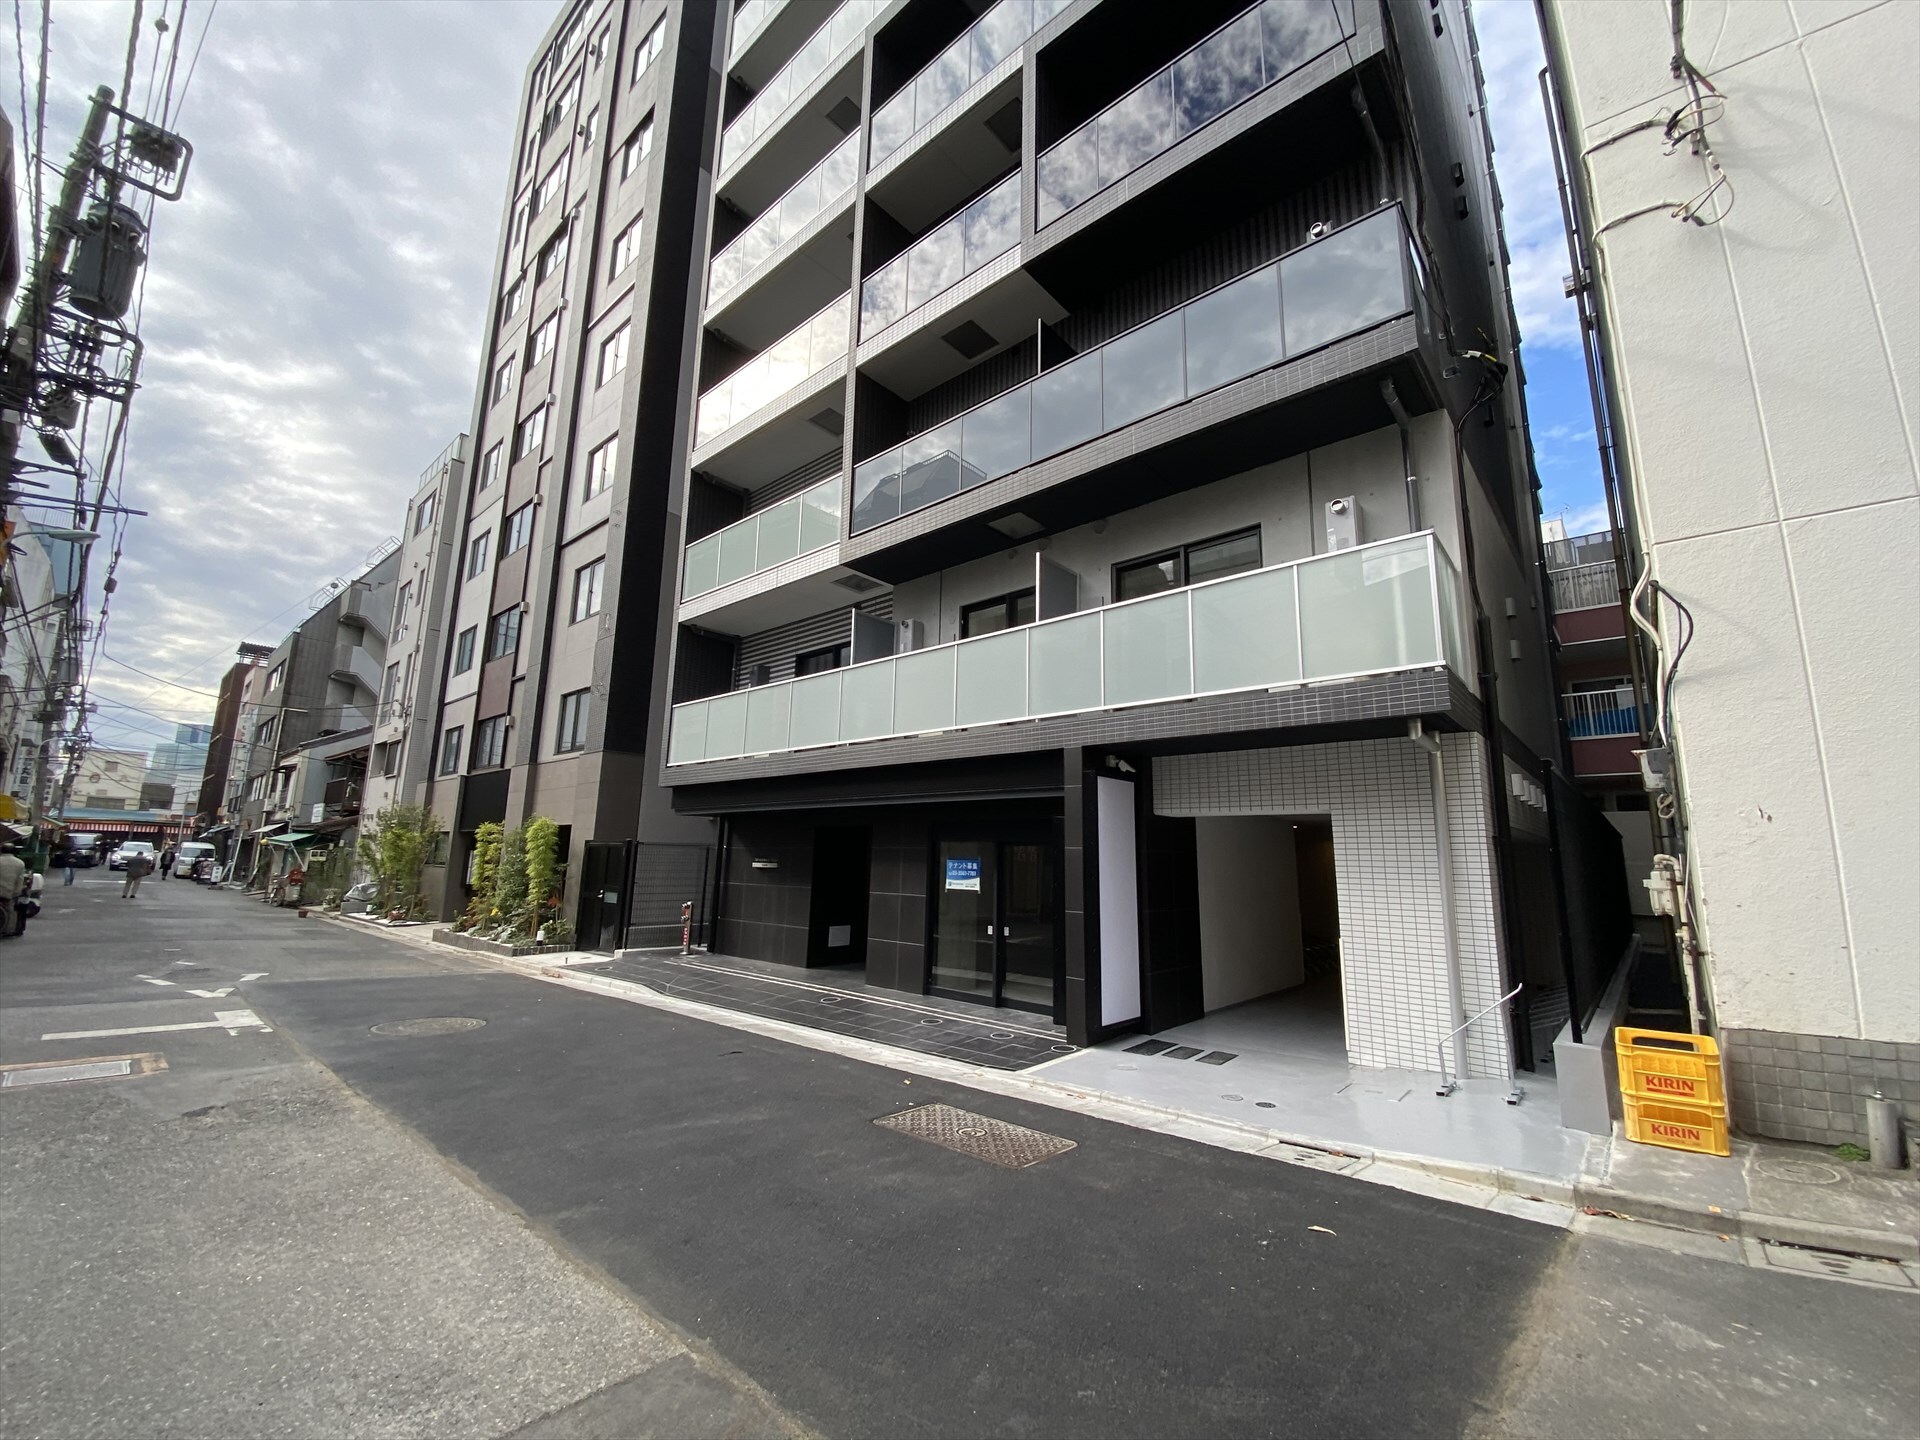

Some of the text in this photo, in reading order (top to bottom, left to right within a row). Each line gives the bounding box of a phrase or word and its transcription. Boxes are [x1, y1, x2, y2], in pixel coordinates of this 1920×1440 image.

[948, 862, 977, 870] テナント募集
[1646, 1076, 1694, 1092] KIRIN
[1651, 1124, 1700, 1140] KIRIN
